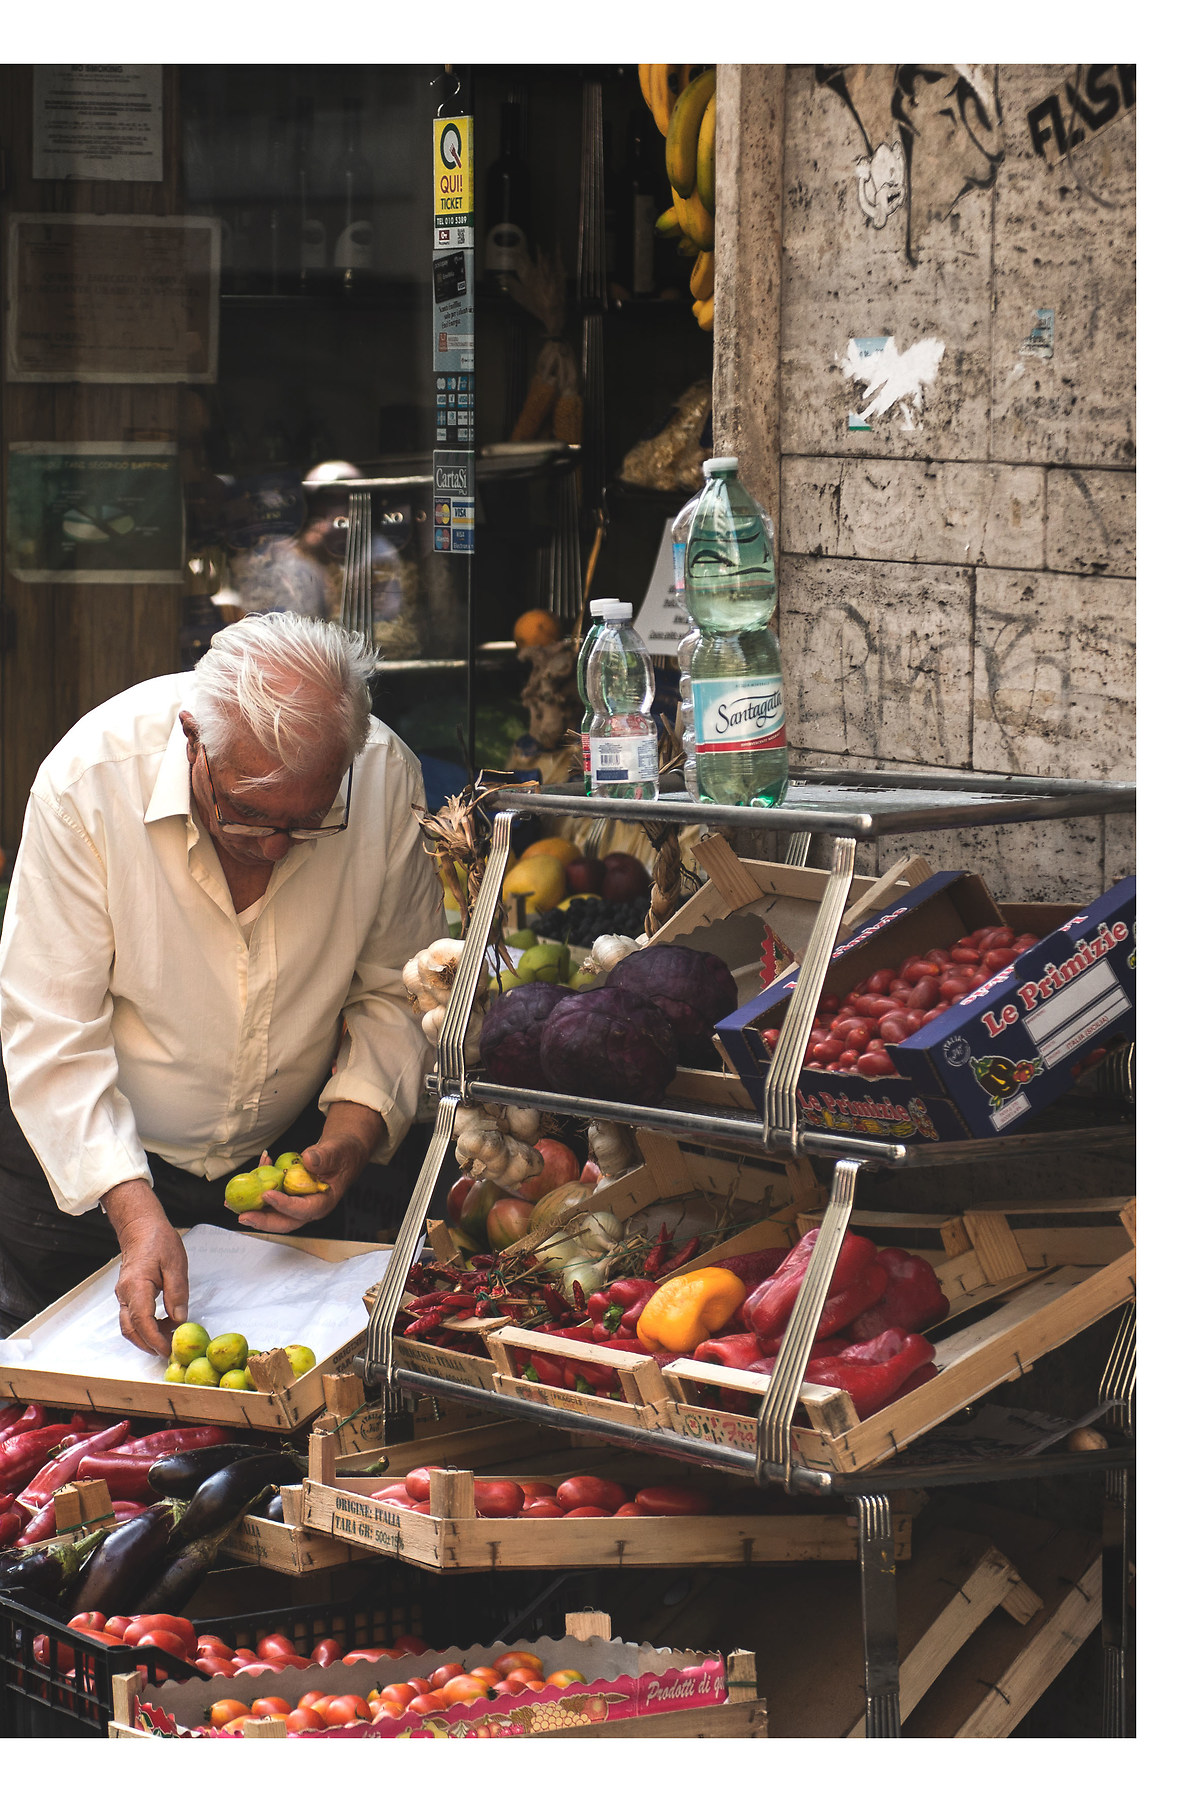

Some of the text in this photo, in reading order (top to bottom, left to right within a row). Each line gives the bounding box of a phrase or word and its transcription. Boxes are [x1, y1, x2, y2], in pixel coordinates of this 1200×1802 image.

[440, 175, 463, 194] QUI!
[440, 197, 463, 210] TICKET
[437, 217, 445, 225] TEL
[454, 508, 467, 518] VISA
[981, 921, 1130, 1039] Le Primizie
[1066, 1032, 1085, 1049] ITALIA
[819, 1092, 911, 1121] Primizie
[336, 1497, 402, 1529] ORIGINE: ITALIA
[335, 1515, 356, 1534] TARA
[645, 1677, 696, 1707] Prodotti
[698, 1672, 712, 1694] di
